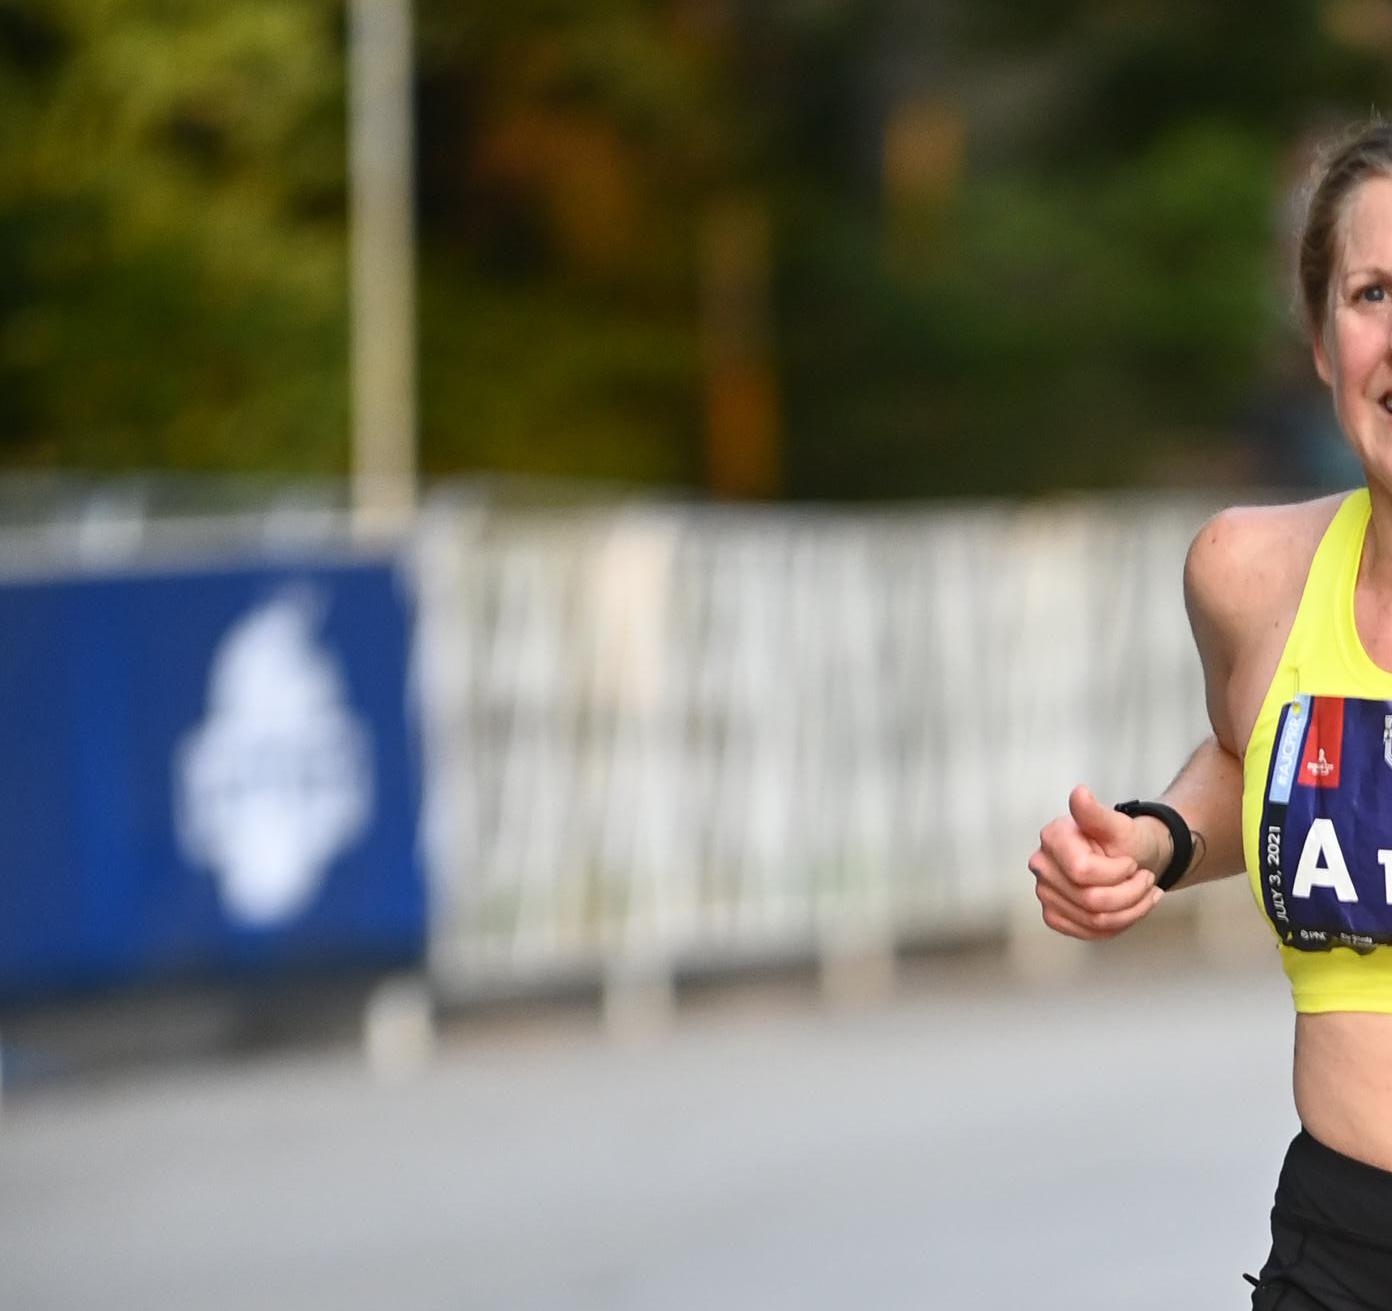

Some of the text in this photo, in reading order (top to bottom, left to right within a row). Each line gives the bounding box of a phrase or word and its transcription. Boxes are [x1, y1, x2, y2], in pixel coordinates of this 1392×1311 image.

[1267, 825, 1289, 922] JULY 3, 2021
[1292, 817, 1358, 902] A
